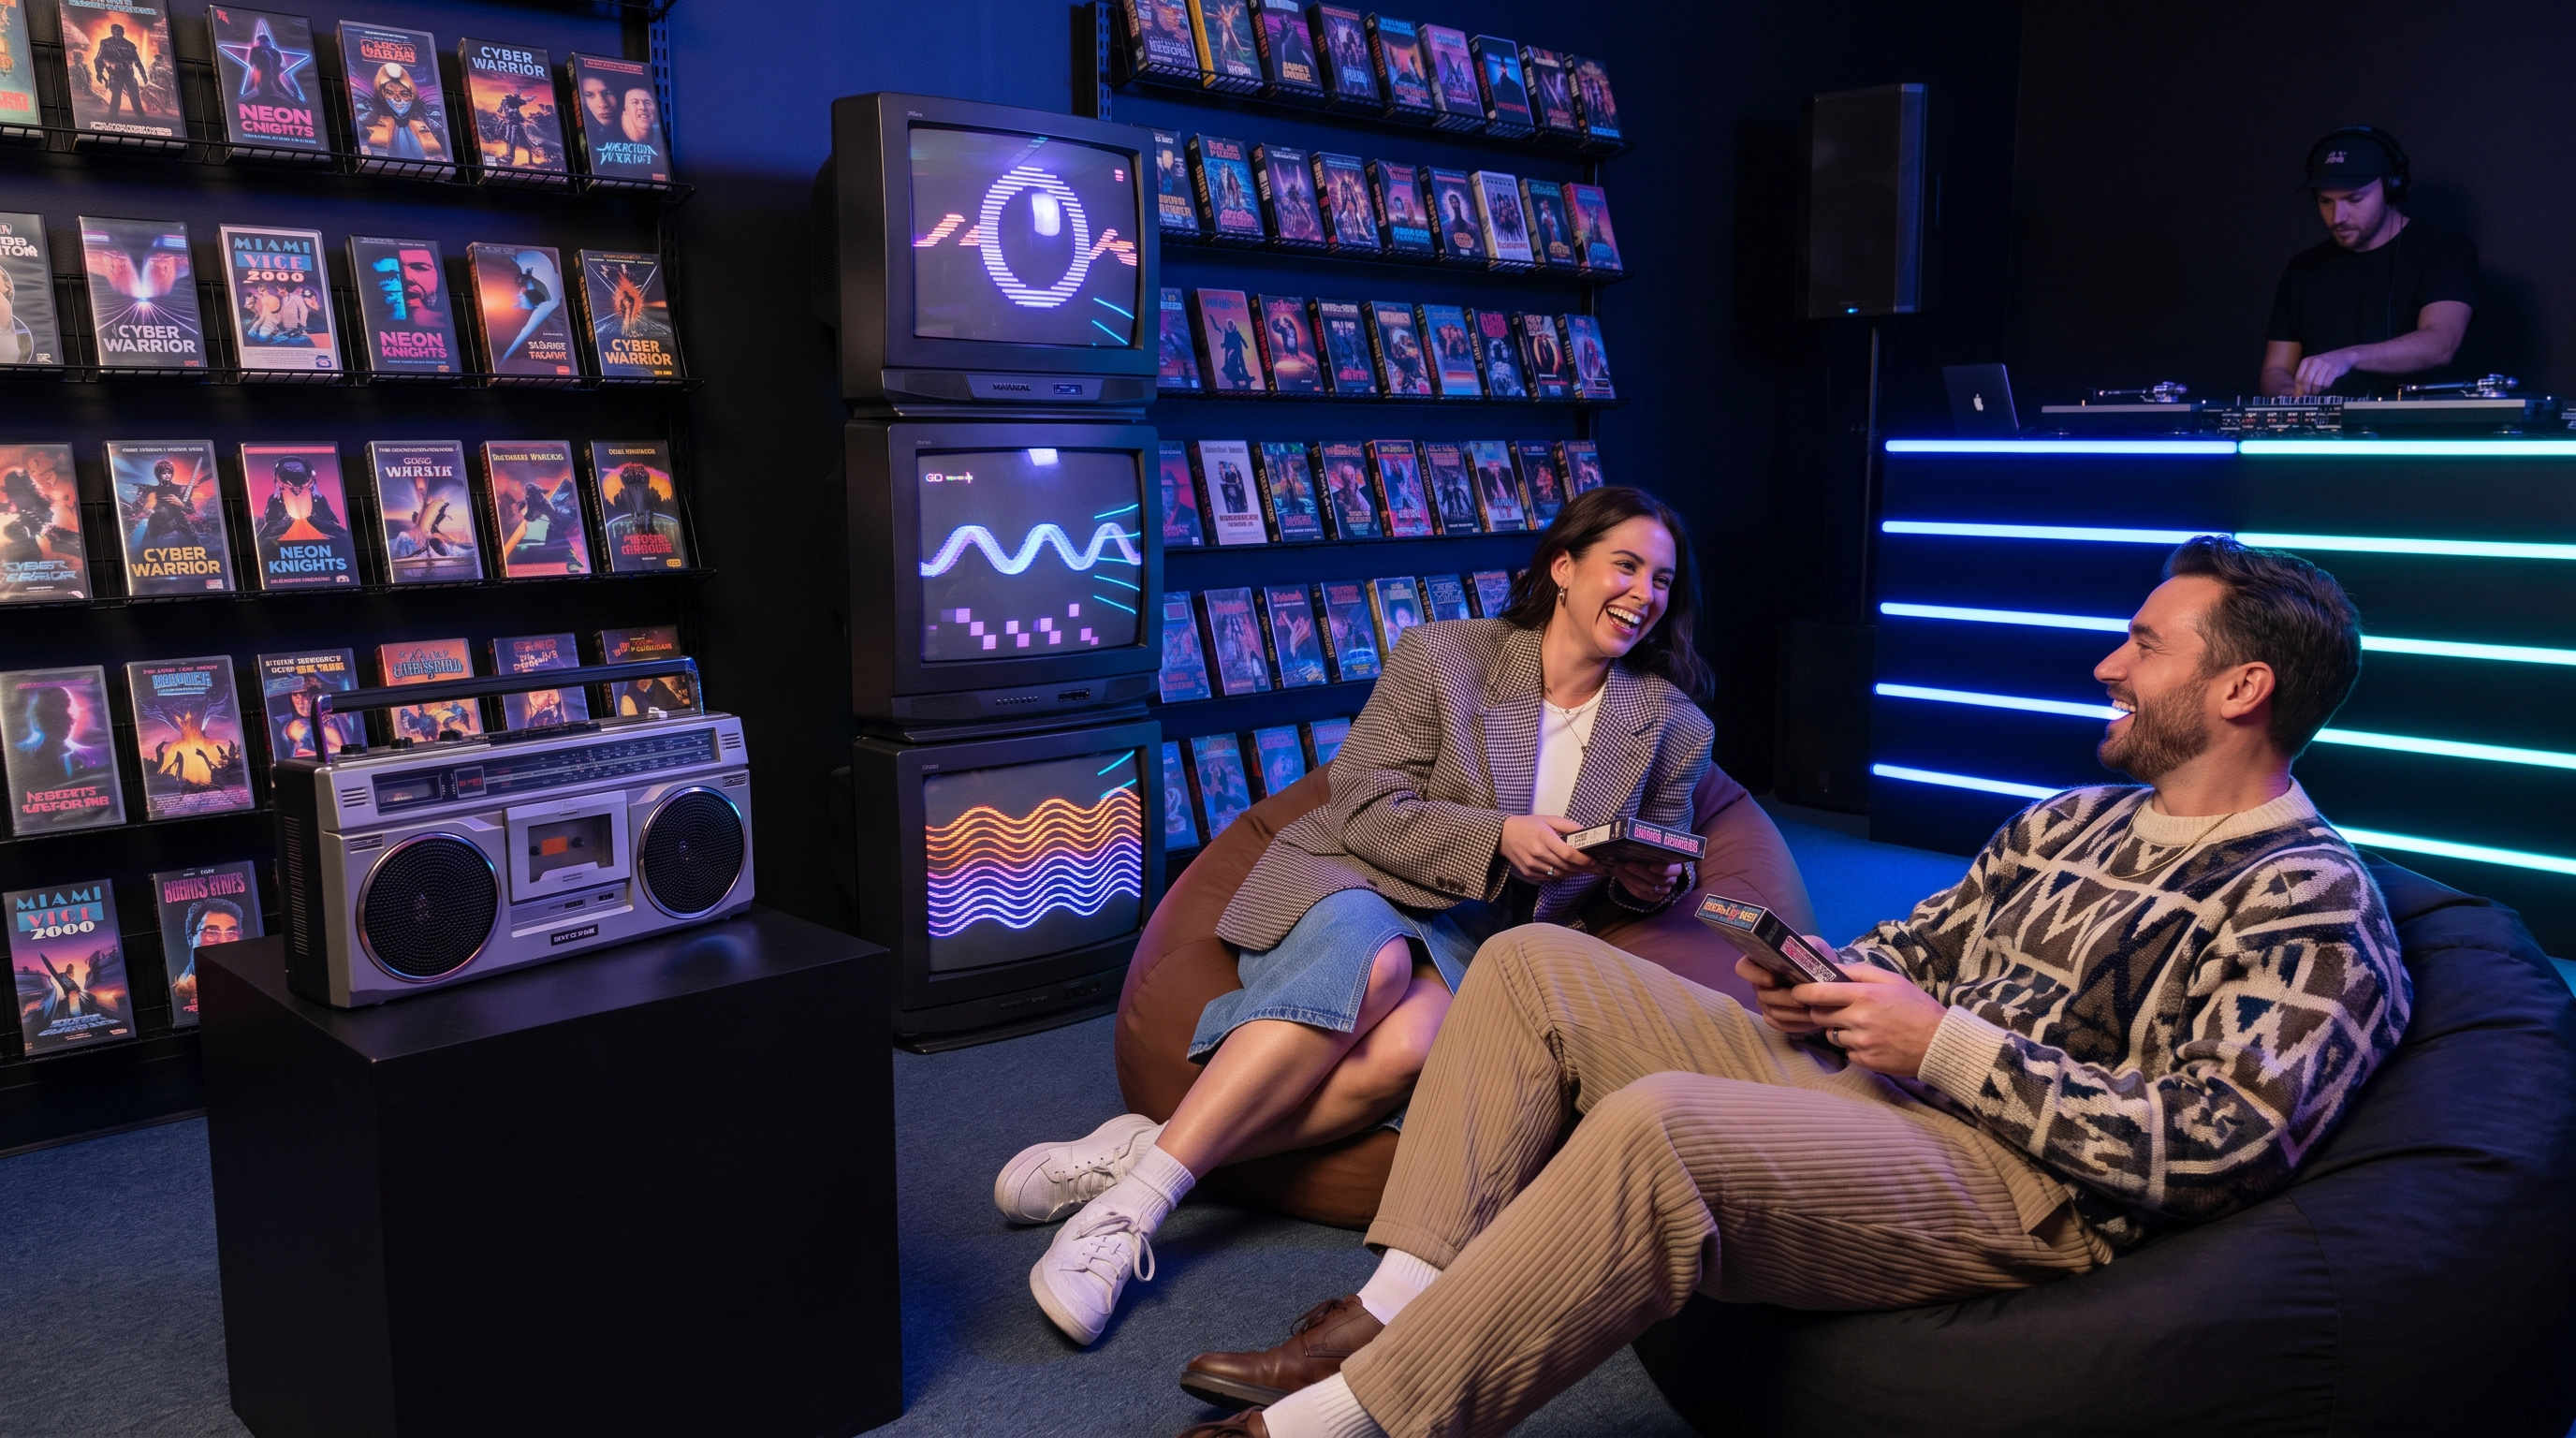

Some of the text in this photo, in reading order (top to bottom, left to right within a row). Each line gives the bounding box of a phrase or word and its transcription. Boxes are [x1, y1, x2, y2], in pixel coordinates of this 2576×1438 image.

[480, 46, 533, 64] CYBER
[472, 57, 545, 78] WARRIOR
[238, 103, 313, 126] NEON
[234, 237, 311, 254] MIAMI
[243, 254, 303, 270] VICE
[242, 270, 305, 284] 2000
[119, 325, 180, 339] CYBER
[379, 330, 445, 347] NEON
[103, 338, 197, 353] WARRIOR
[381, 346, 447, 359] KNIGHTS
[611, 338, 660, 353] CYBER
[604, 351, 673, 366] WARRIOR
[143, 546, 207, 561] CYBER
[279, 545, 332, 559] NEON
[131, 560, 221, 577] WARRIOR
[268, 557, 347, 574] KNIGHTS
[16, 886, 102, 910] MIAMI
[27, 906, 95, 928] VICE
[30, 920, 95, 940] 2000
